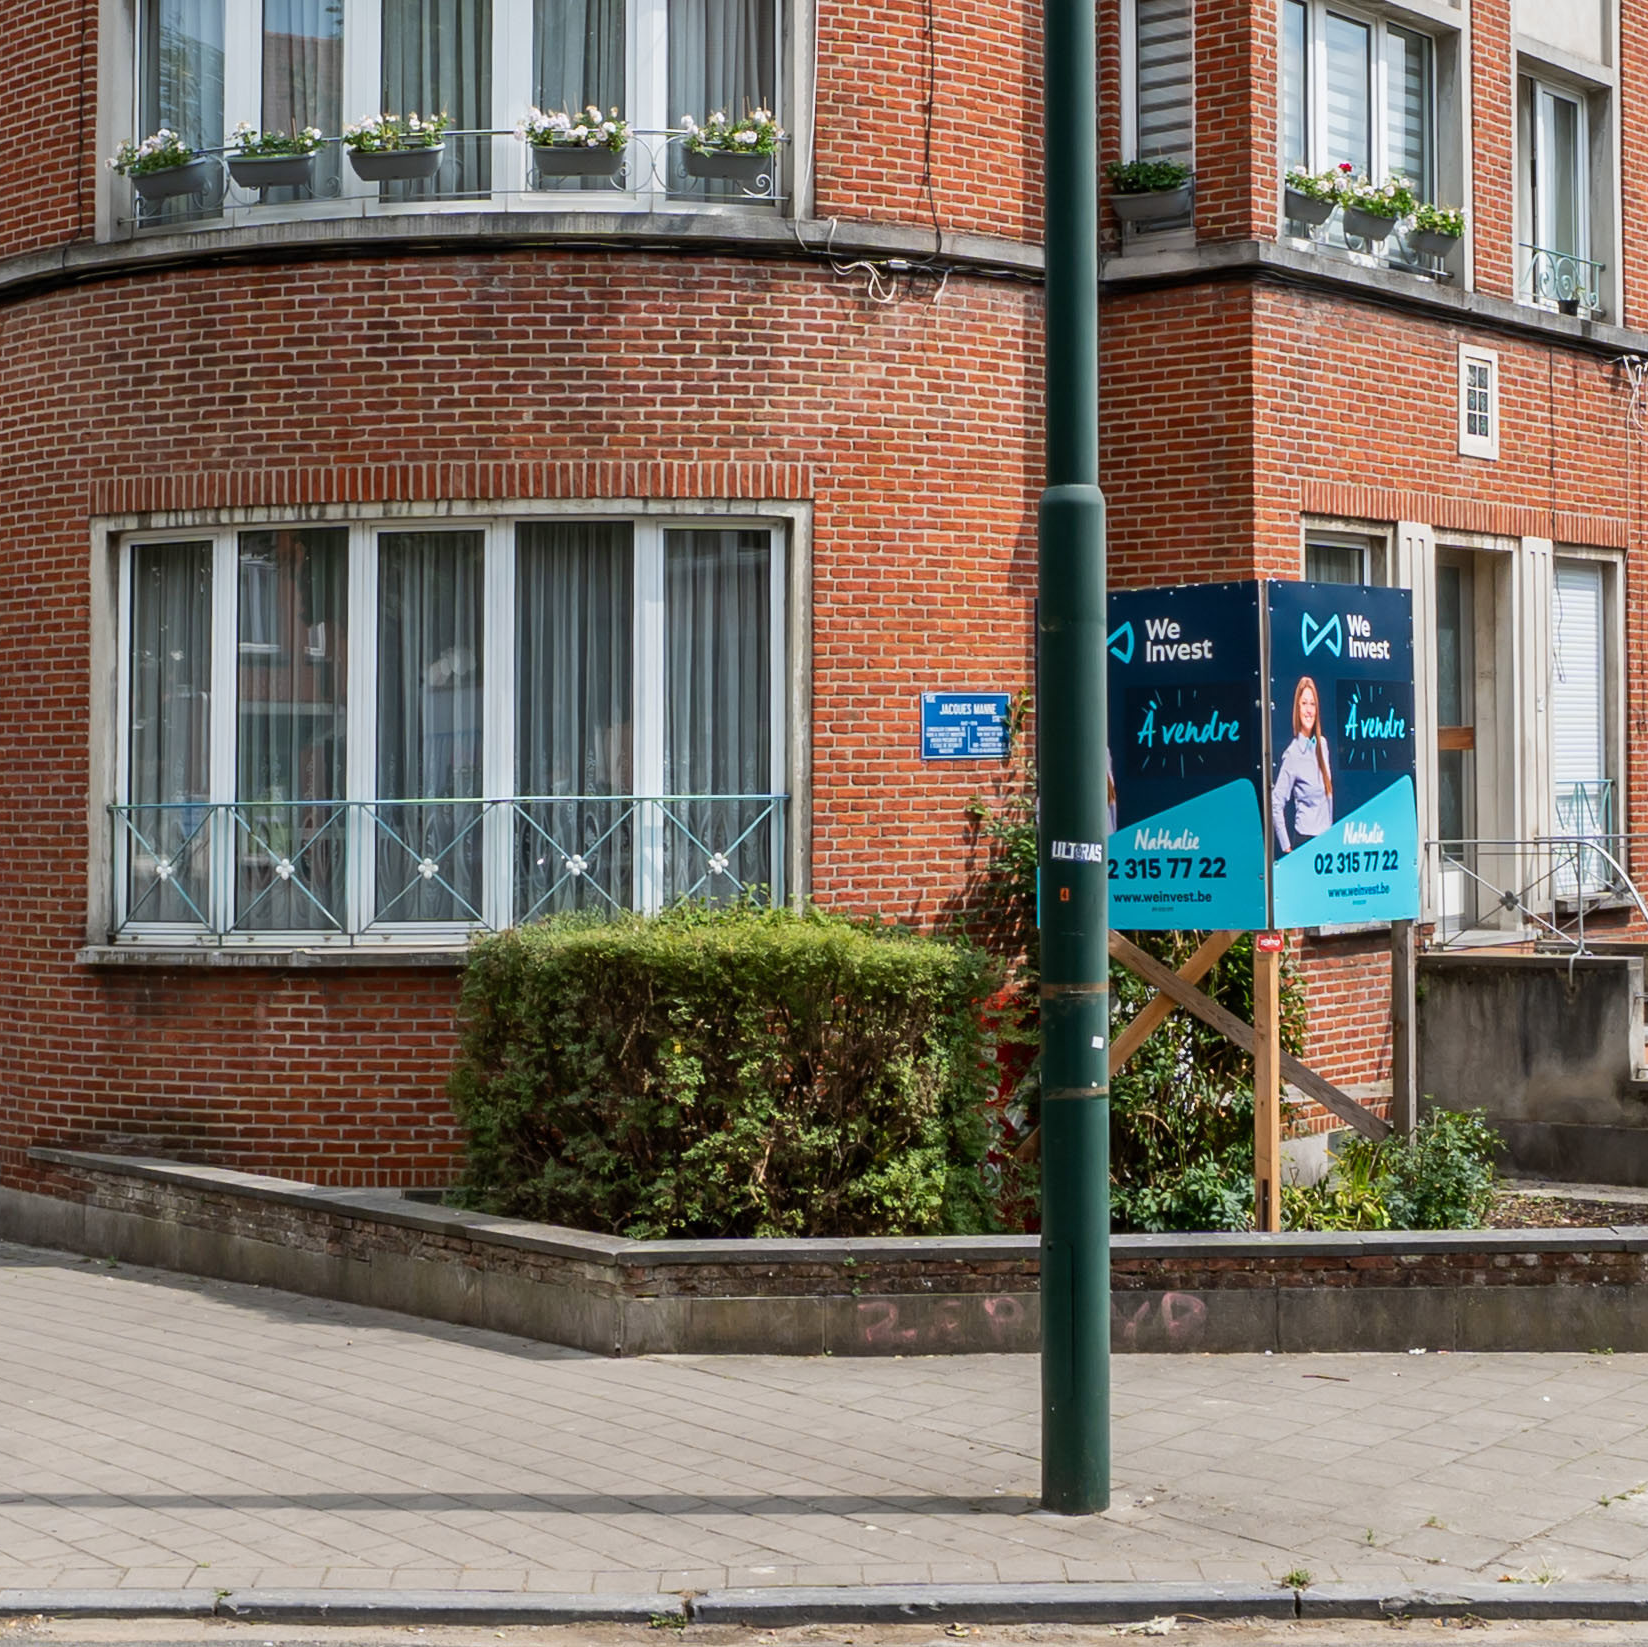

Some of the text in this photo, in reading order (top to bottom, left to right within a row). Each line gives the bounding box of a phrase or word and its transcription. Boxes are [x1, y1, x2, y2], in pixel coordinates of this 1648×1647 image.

[1145, 618, 1181, 641] We
[1346, 614, 1371, 637] We
[1146, 639, 1213, 663] Invest
[1348, 637, 1390, 660] Invest
[939, 703, 997, 715] JACQUES MANNE
[1344, 694, 1405, 741] À vendre
[1137, 700, 1240, 748] À vendre
[1134, 827, 1200, 851] Nathalie
[1343, 821, 1385, 845] Nathalie
[1108, 857, 1226, 880] 2 315 77 22
[1314, 850, 1398, 875] 02 315 77 22
[1113, 890, 1212, 903] www.weinvest.be
[1327, 882, 1390, 897] www.weinvest.be
